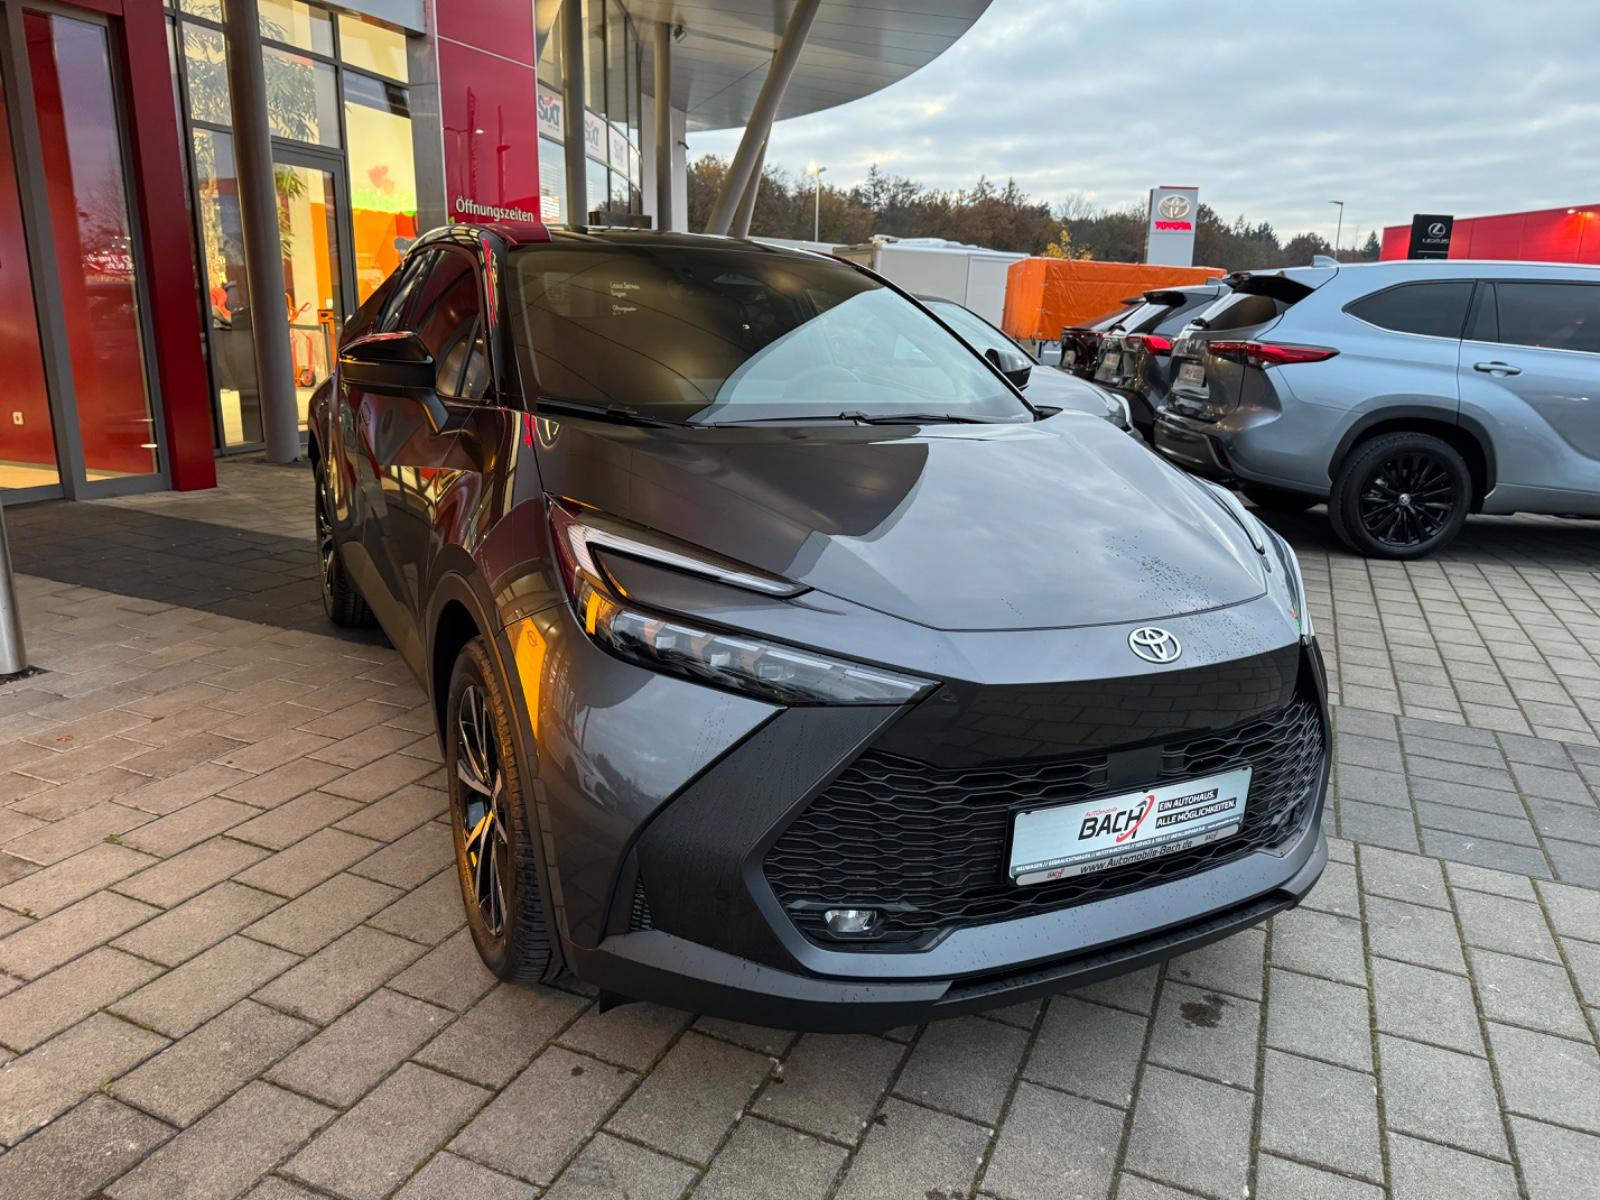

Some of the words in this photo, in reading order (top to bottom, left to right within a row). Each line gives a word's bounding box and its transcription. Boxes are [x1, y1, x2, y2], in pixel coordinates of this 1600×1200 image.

[455, 195, 534, 222] Öffnungszeiten
[1154, 220, 1192, 231] TOYOTA
[1157, 815, 1176, 827] ALLE
[1178, 800, 1235, 823] MÖGLICHKEITEN.
[1159, 801, 1172, 810] EIN
[1173, 791, 1215, 808] AUTOHAUS.
[1078, 802, 1146, 841] BACH
